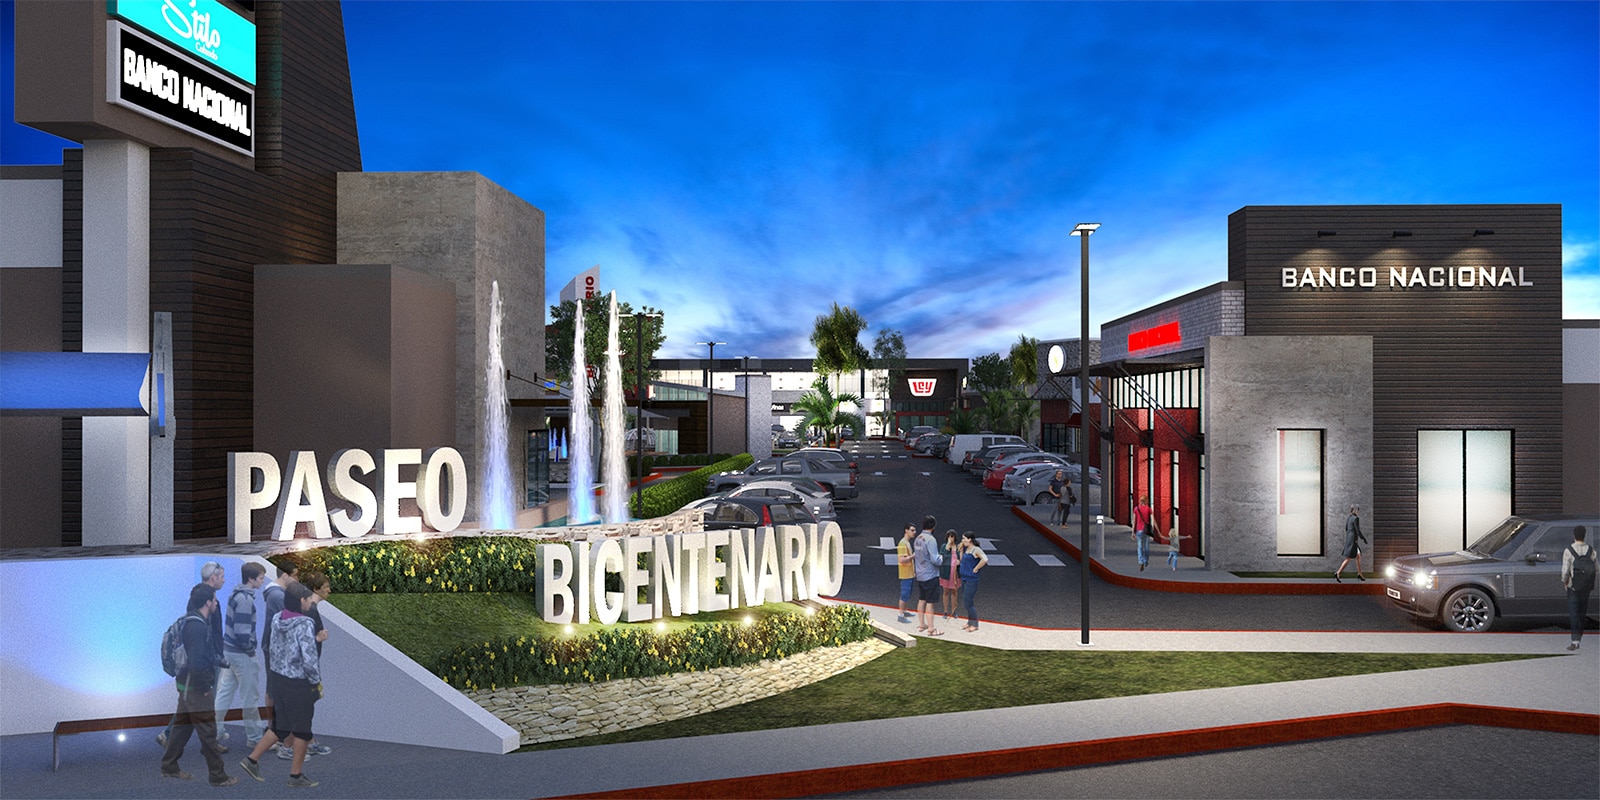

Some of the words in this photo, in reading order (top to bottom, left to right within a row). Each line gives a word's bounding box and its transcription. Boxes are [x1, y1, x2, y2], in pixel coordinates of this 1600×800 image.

[123, 47, 180, 104] BANCO
[182, 76, 251, 137] NACIONAL
[1281, 266, 1377, 288] BANCO
[1389, 265, 1534, 288] NACIONAL
[227, 446, 468, 544] PASEO
[535, 520, 844, 625] BICENTENARIO
